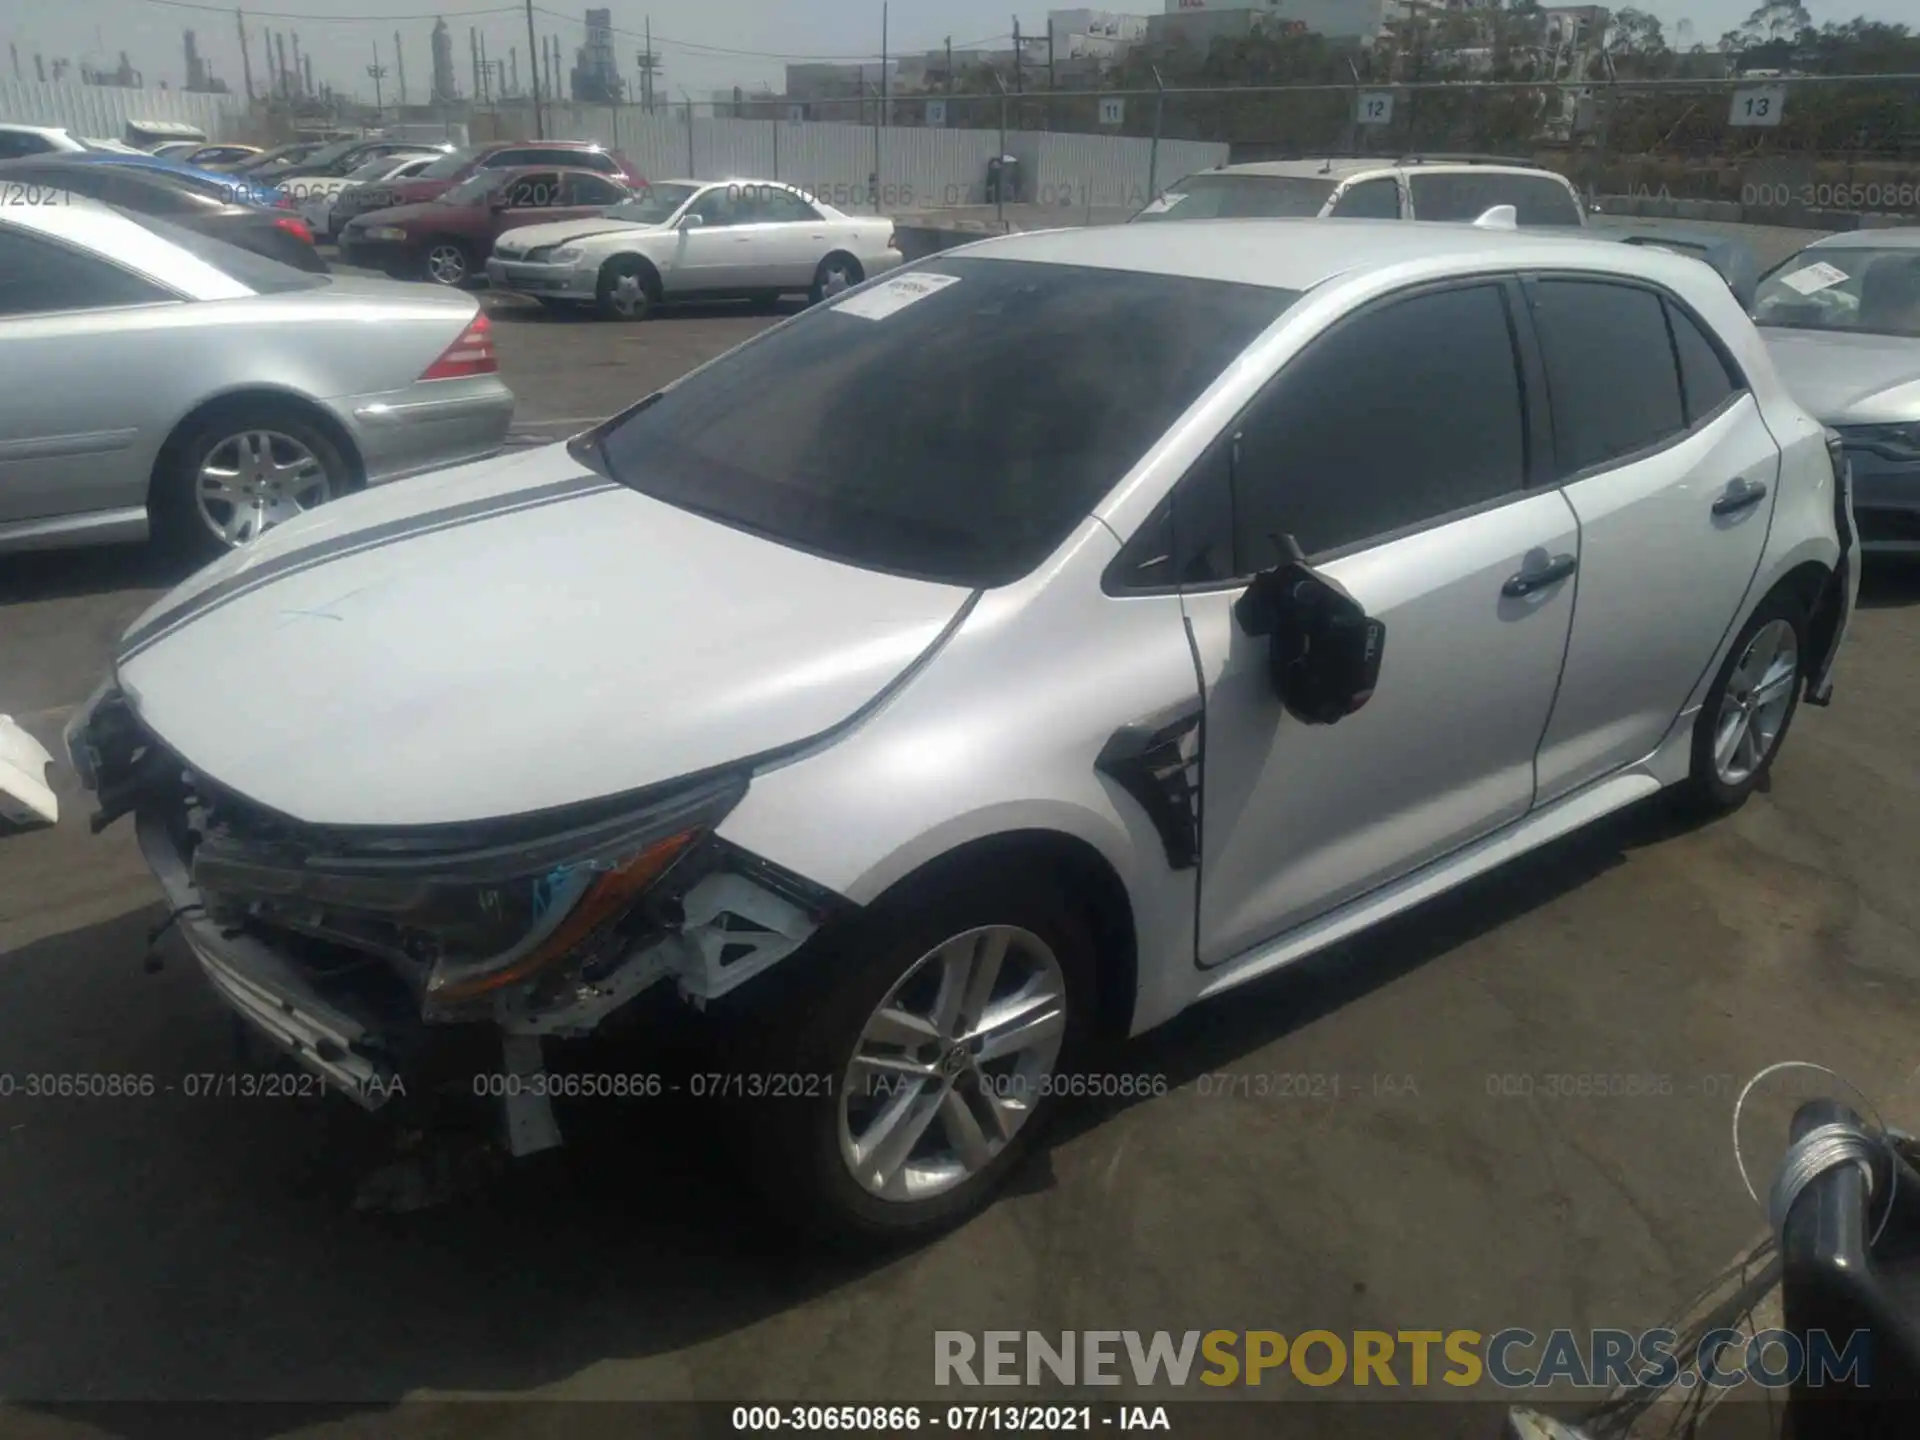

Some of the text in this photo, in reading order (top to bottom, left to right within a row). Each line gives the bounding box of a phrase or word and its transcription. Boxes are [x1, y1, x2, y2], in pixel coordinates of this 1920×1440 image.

[1106, 105, 1118, 119] 11
[1368, 101, 1384, 118] 12
[1745, 97, 1769, 117] 13
